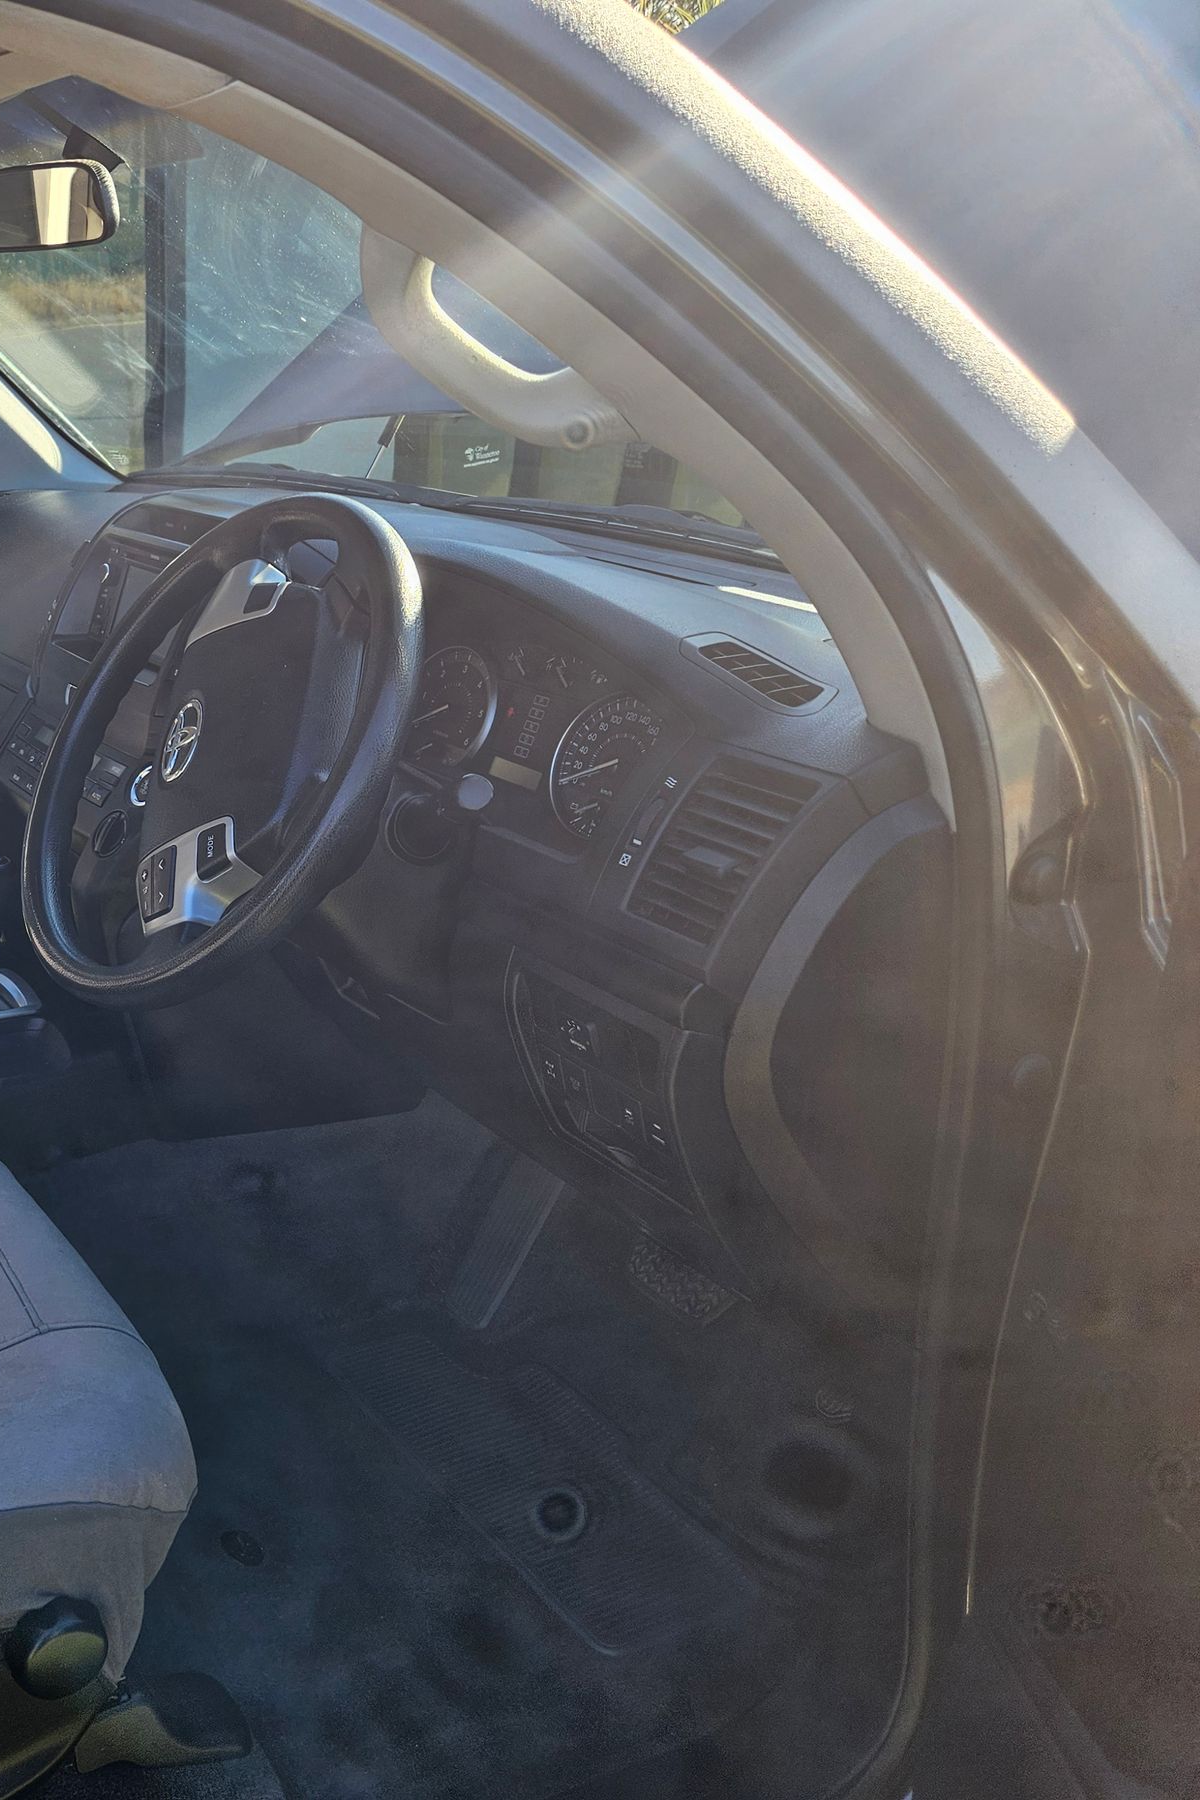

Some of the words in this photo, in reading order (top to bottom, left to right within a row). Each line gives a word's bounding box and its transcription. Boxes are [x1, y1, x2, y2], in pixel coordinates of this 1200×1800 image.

[478, 710, 484, 718] 5
[625, 711, 638, 721] 120
[610, 715, 623, 725] 100
[638, 715, 651, 726] 140
[599, 722, 609, 732] 80
[463, 738, 469, 746] 6
[587, 732, 598, 742] 60
[579, 746, 588, 755] 40
[574, 760, 583, 770] 20
